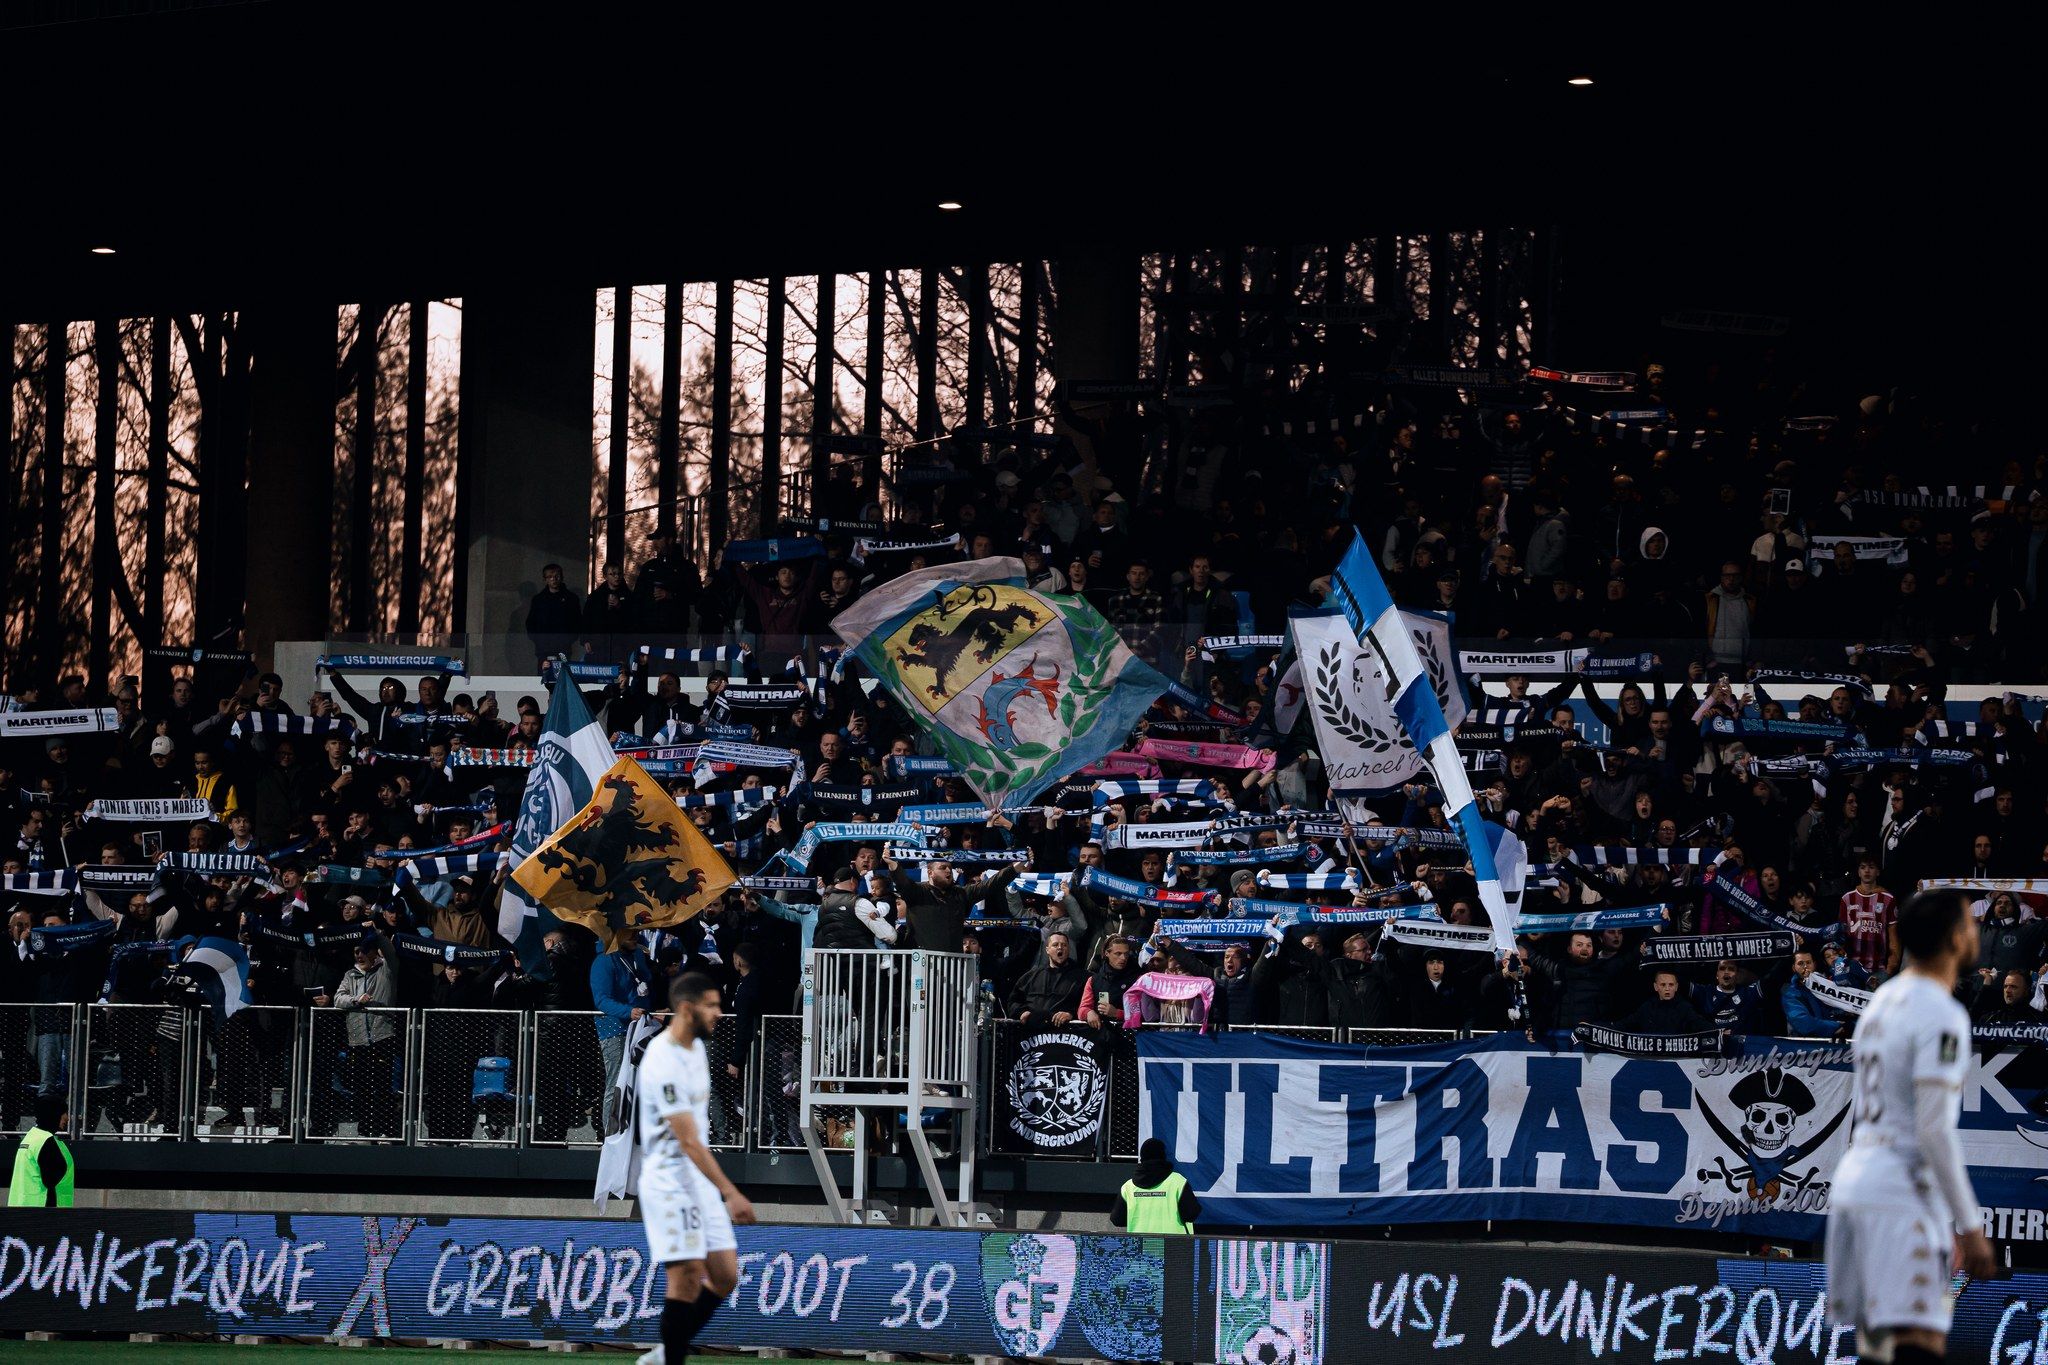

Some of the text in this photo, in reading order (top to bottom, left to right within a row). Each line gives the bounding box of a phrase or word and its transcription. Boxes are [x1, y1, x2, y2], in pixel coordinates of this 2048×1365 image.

[344, 655, 436, 666] USL DUNKERQUE
[1467, 655, 1556, 664] MARITIMES
[1589, 657, 1636, 668] USL DUNKERQUE
[7, 715, 89, 727] MARITIMES
[1931, 748, 1974, 759] PARIS
[1326, 753, 1406, 781] Marcel
[98, 799, 131, 816] CONTRE
[133, 800, 160, 816] VENTS
[163, 801, 170, 815] &
[904, 809, 922, 821] US
[817, 825, 842, 838] USL
[846, 824, 920, 841] DUNKERQUE
[182, 852, 257, 871] DUNKERQUE
[1180, 851, 1226, 859] DUNKERQUE
[1107, 876, 1140, 896] DUNKERQUE
[1252, 902, 1300, 914] USL DUNKERQUE
[1311, 909, 1406, 923] USL DUNKERQUE
[1163, 922, 1212, 936] DUNKERQUE
[1234, 922, 1263, 933] ALLEZ
[1860, 919, 1882, 928] INTER
[1392, 924, 1490, 941] MARITIMES
[1020, 1033, 1095, 1054] DUINKERKE
[1696, 1044, 1855, 1078] Dunkerque
[1009, 1117, 1100, 1148] UNDERGROUND
[1144, 1056, 1693, 1195] ULTRAS
[1674, 1187, 1832, 1229] Depuis 200
[681, 1206, 700, 1230] 18
[0, 1230, 326, 1319] DUNKERQUE
[426, 1236, 664, 1330] GRENOBL
[880, 1261, 957, 1329] 38
[995, 1280, 1059, 1331] GF
[1368, 1272, 1465, 1349] USL
[1491, 1274, 1859, 1365] DUNKERQUE
